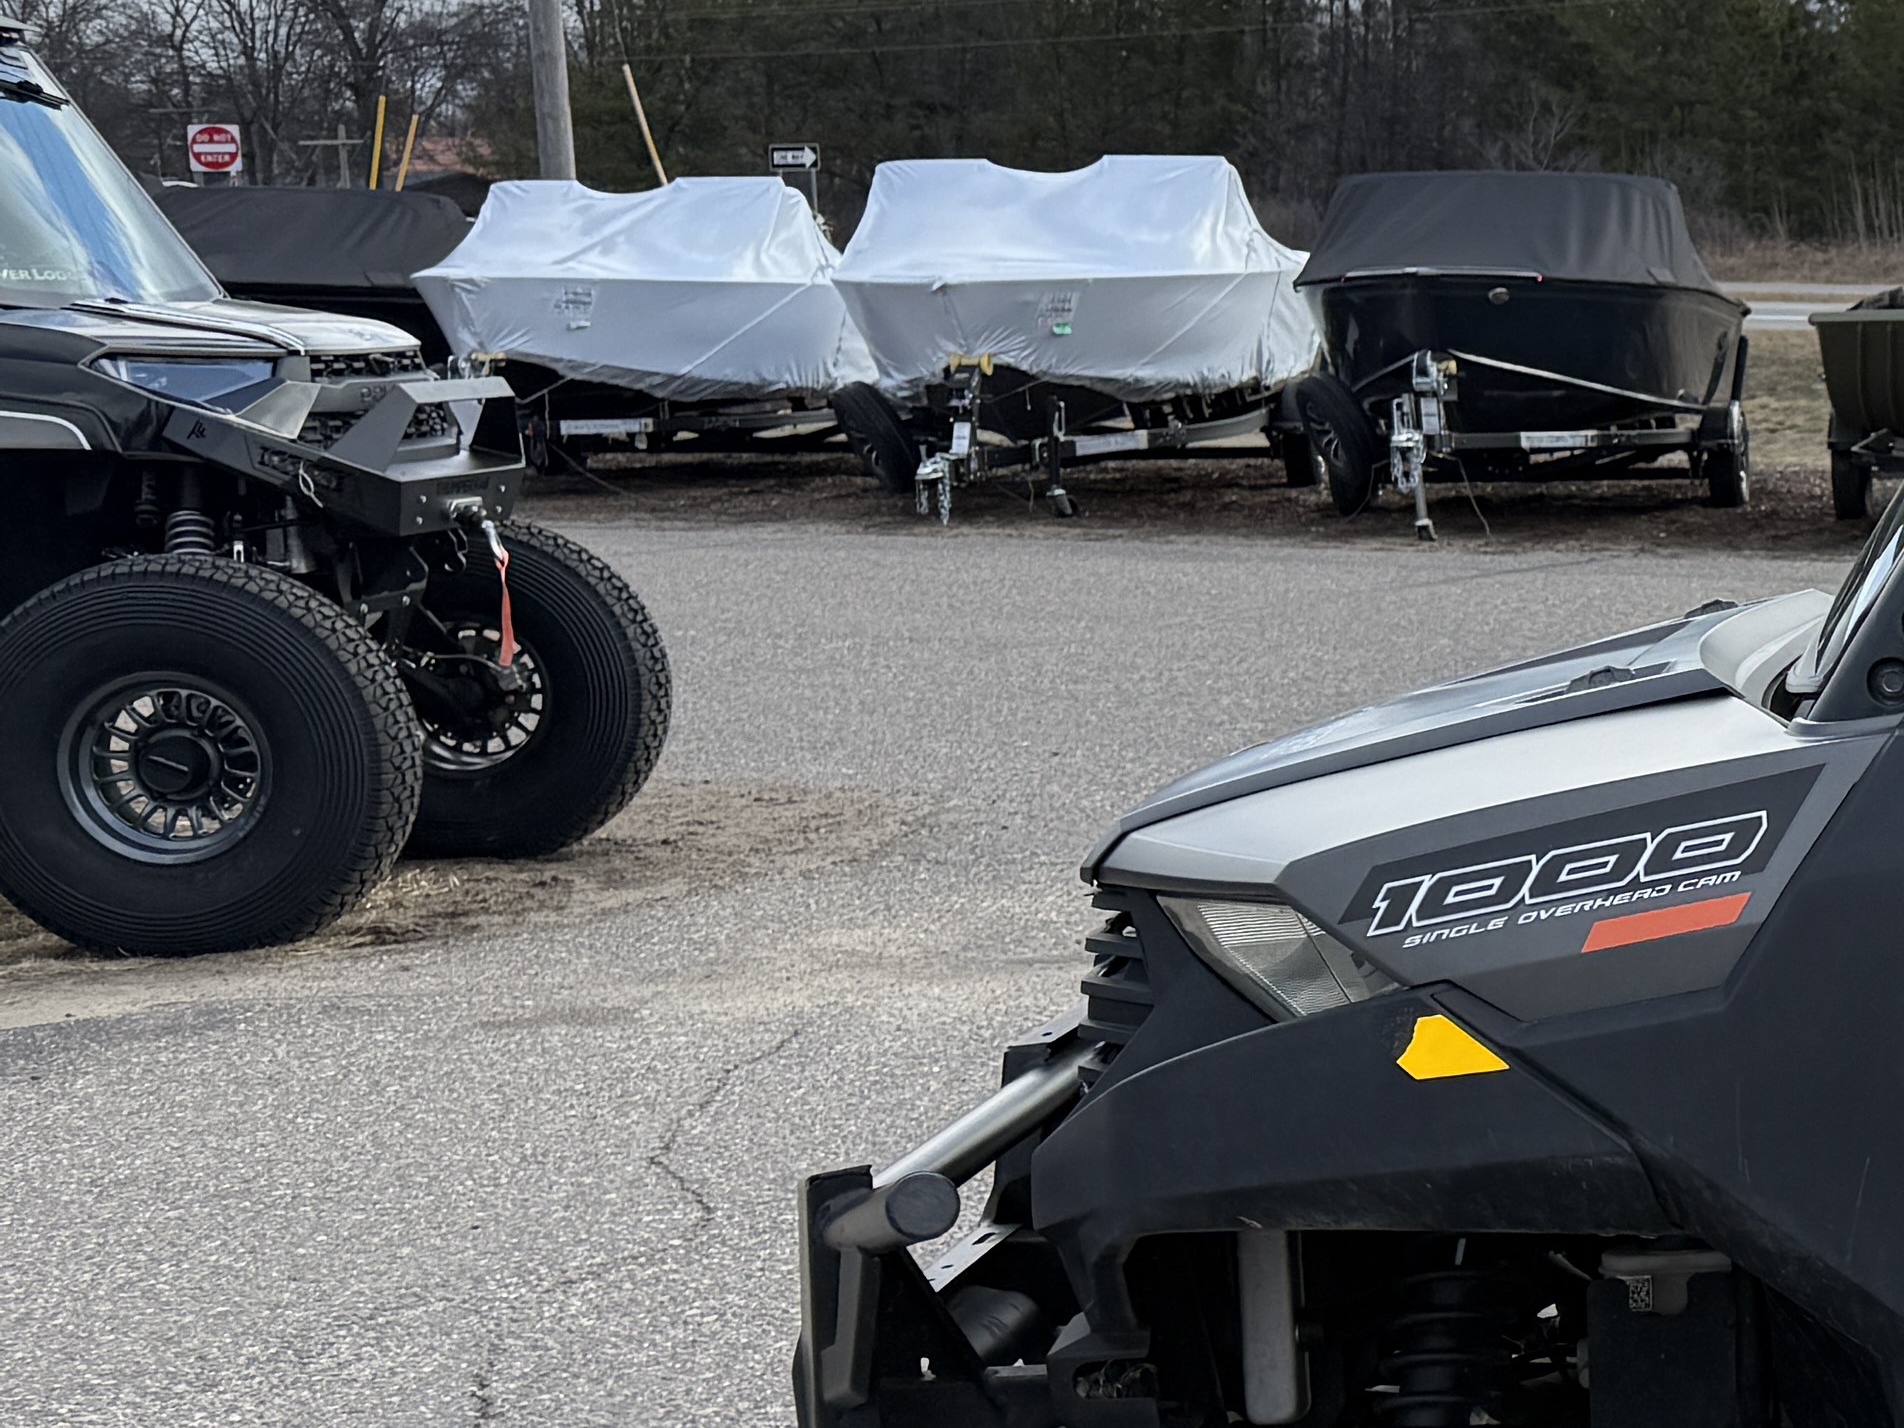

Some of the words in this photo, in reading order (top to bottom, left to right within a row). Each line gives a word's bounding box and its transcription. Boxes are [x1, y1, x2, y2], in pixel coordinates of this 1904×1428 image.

[196, 133, 210, 143] DO
[213, 133, 232, 143] NOT
[201, 154, 231, 164] ENTER
[1367, 810, 1768, 936] 1000
[1402, 916, 1508, 949] SINGLE
[1517, 886, 1669, 926] OVERHEAD
[1676, 871, 1742, 894] CAM
